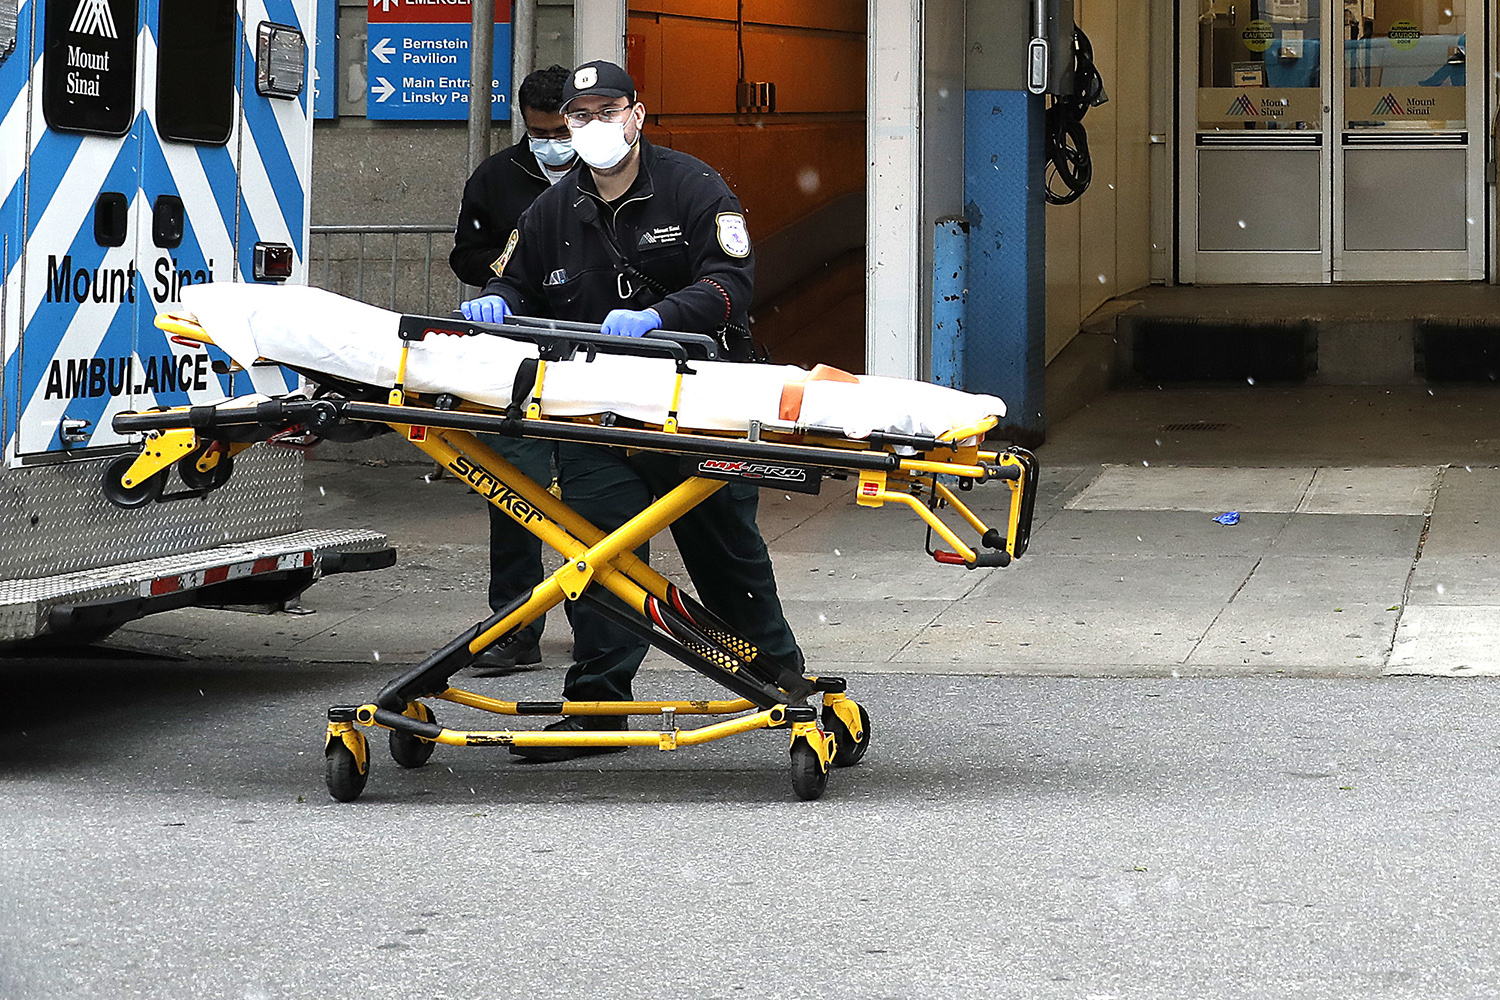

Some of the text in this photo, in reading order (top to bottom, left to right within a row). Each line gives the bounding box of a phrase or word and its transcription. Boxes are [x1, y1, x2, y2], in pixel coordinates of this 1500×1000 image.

[403, 38, 468, 49] Bernstein
[67, 44, 110, 72] Mount
[403, 53, 457, 64] Pavilion
[66, 71, 100, 97] Sinai
[402, 77, 499, 88] Main Entre
[402, 92, 506, 105] Linsky Paon
[1406, 98, 1435, 106] Mount
[1260, 107, 1284, 116] Sinai
[1406, 107, 1430, 115] Sinai
[46, 254, 137, 304] Mount
[44, 353, 208, 400] AMBULANCE
[703, 459, 803, 477] MX-PRO
